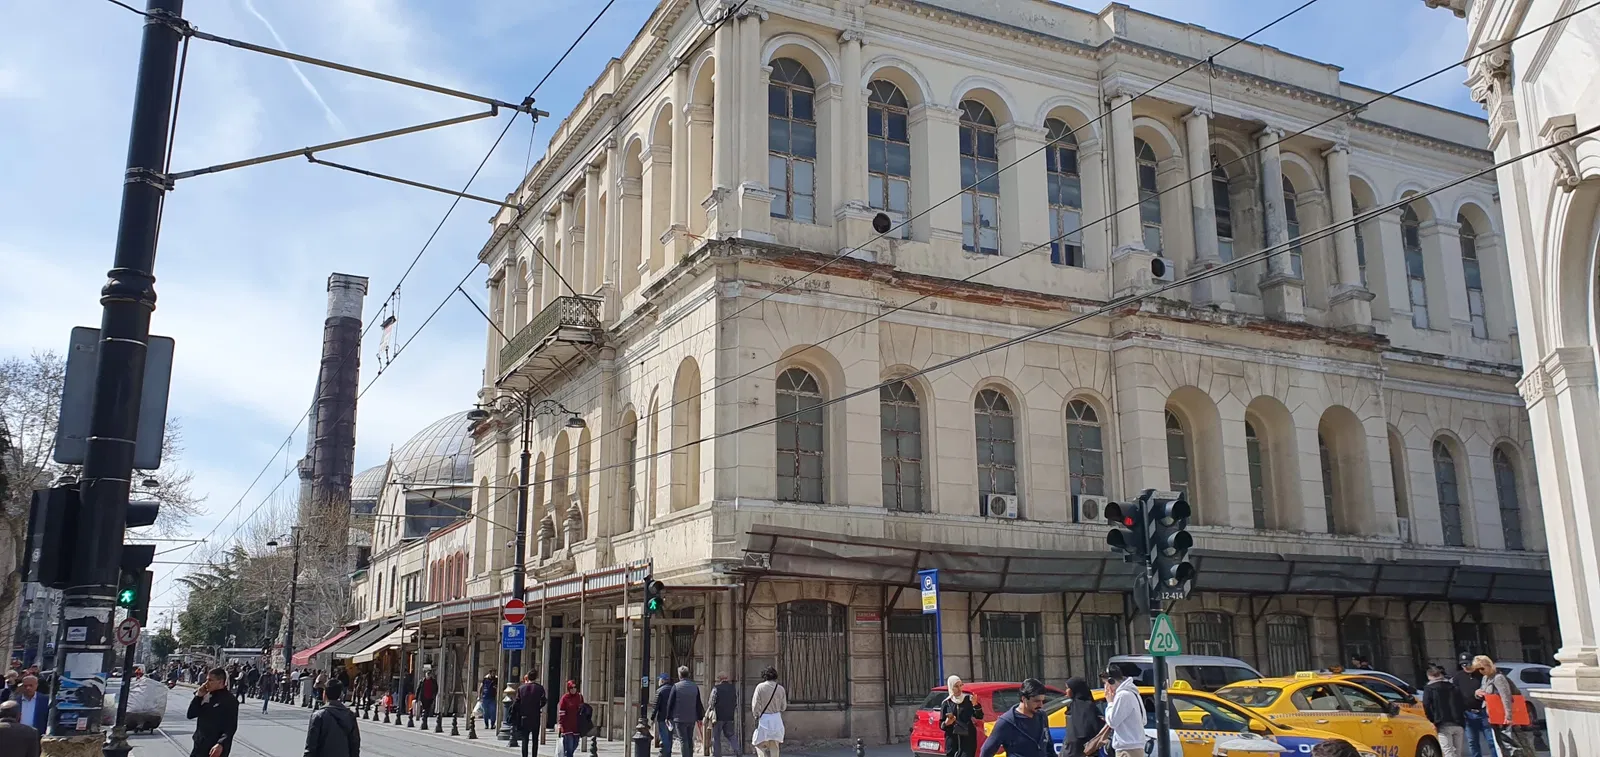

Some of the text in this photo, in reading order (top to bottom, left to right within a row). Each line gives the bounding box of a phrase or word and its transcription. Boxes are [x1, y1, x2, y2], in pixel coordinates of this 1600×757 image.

[1161, 592, 1183, 600] 12-414
[1157, 632, 1173, 649] 20
[1388, 744, 1399, 757] 42
